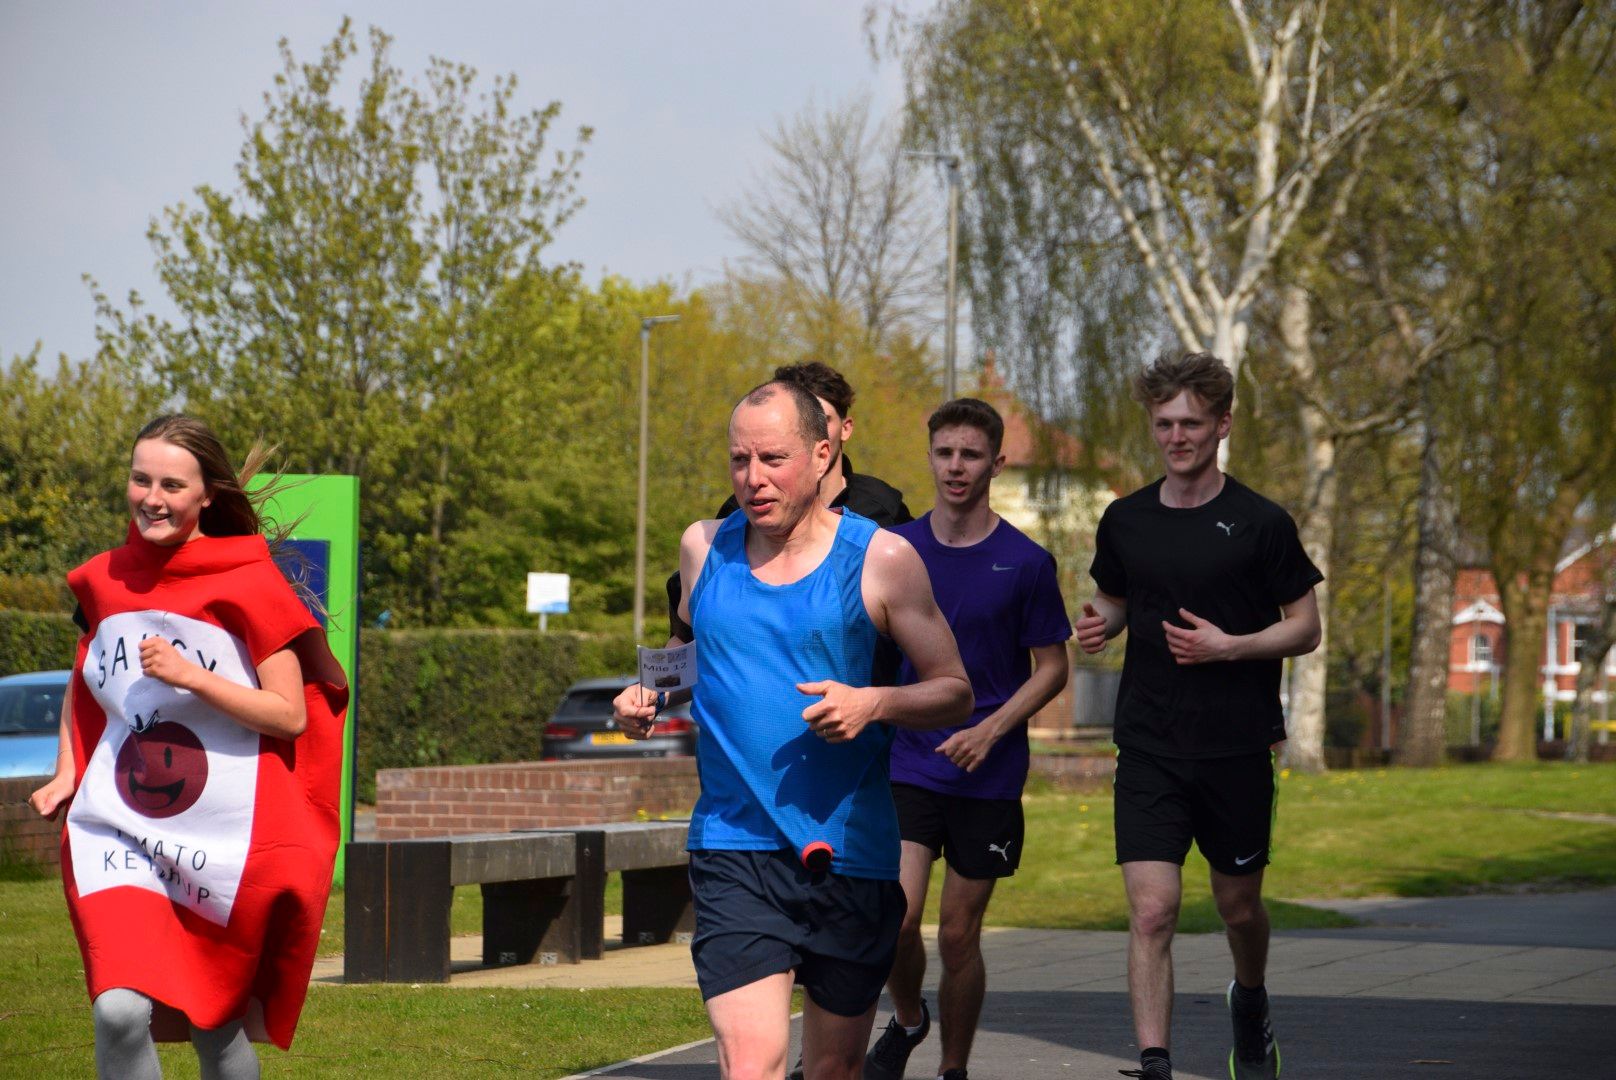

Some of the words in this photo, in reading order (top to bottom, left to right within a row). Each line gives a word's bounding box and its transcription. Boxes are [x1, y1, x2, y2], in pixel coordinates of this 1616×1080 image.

[98, 633, 217, 689] SAY
[643, 663, 669, 672] Mile
[116, 829, 206, 871] MATO
